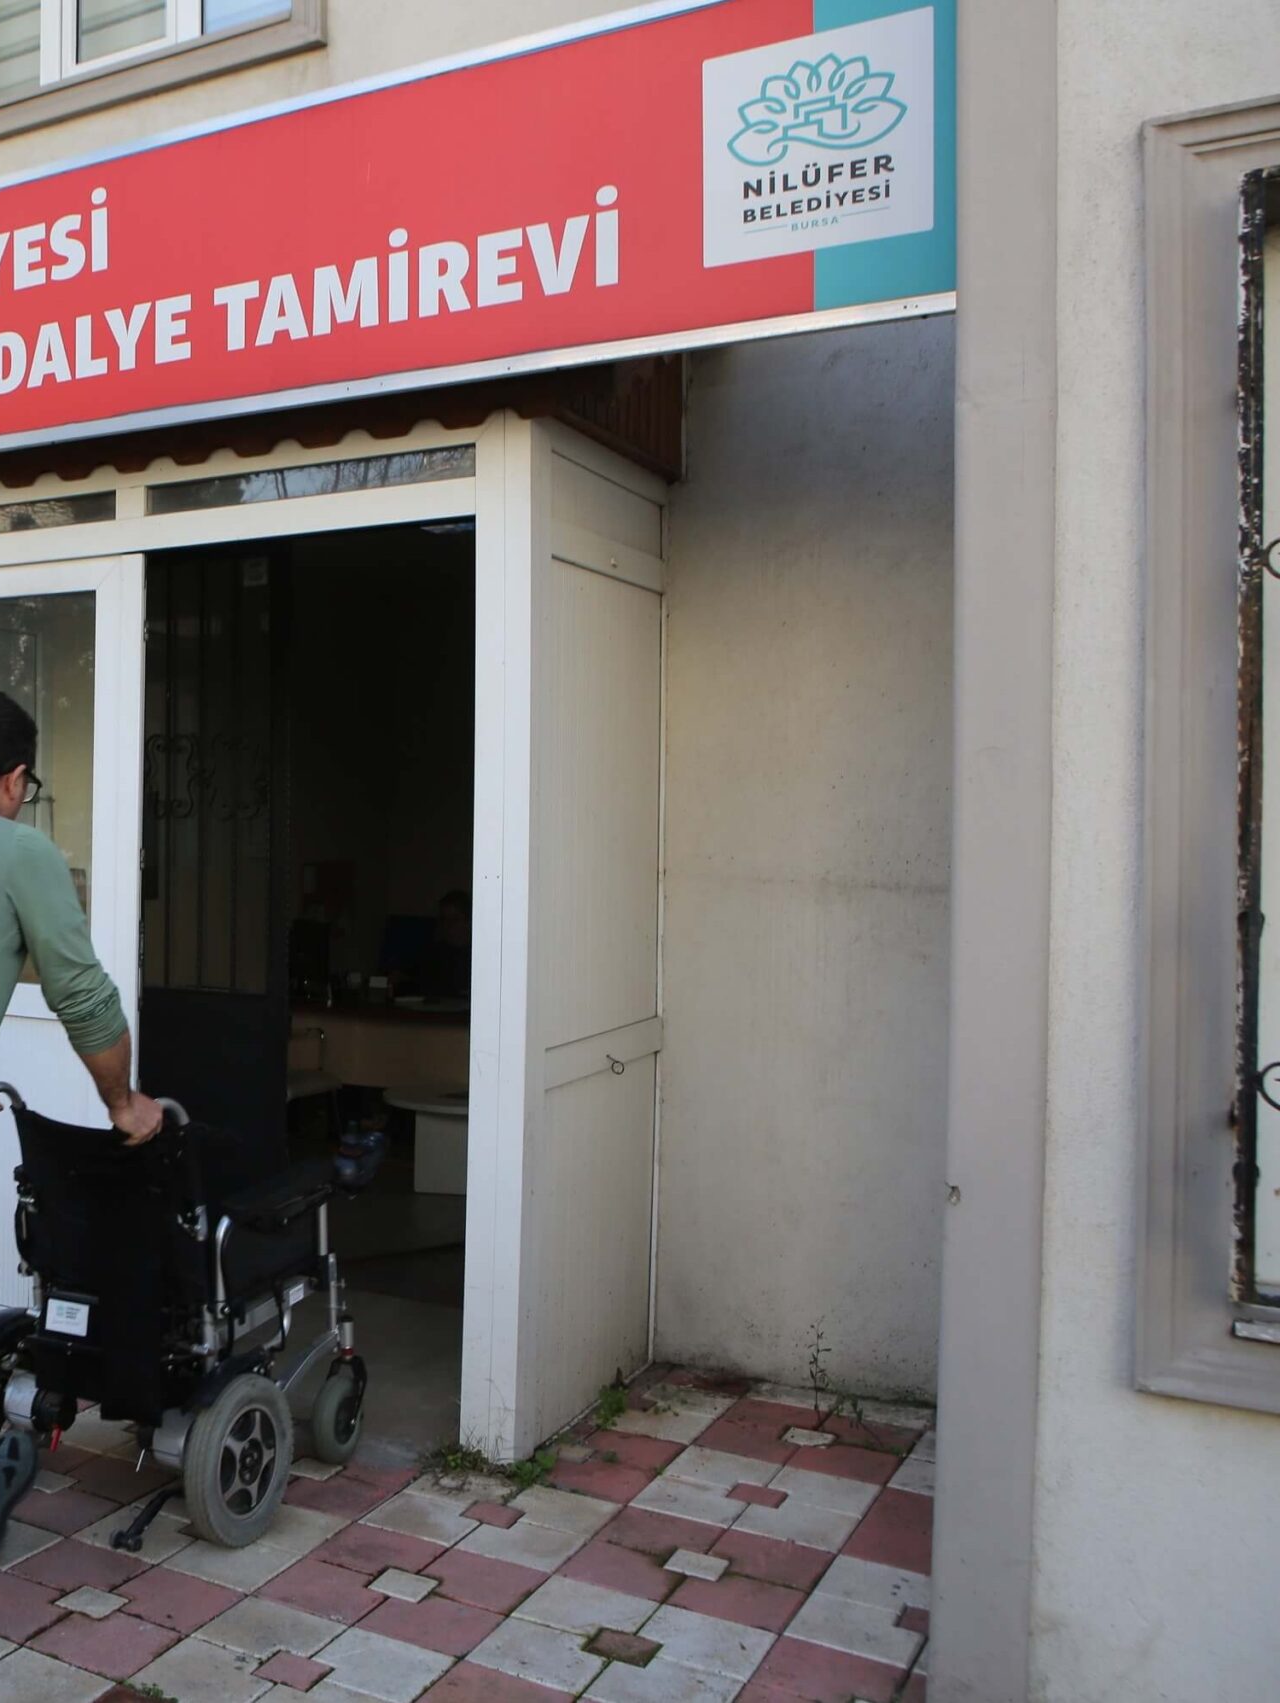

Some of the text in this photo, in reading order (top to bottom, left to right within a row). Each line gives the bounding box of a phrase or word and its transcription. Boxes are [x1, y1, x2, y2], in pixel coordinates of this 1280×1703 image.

[743, 154, 895, 200] NİLÜFER
[742, 179, 891, 224] BELEDİYESİ
[790, 215, 840, 232] BURSA
[213, 185, 619, 352] TAMİREVİ
